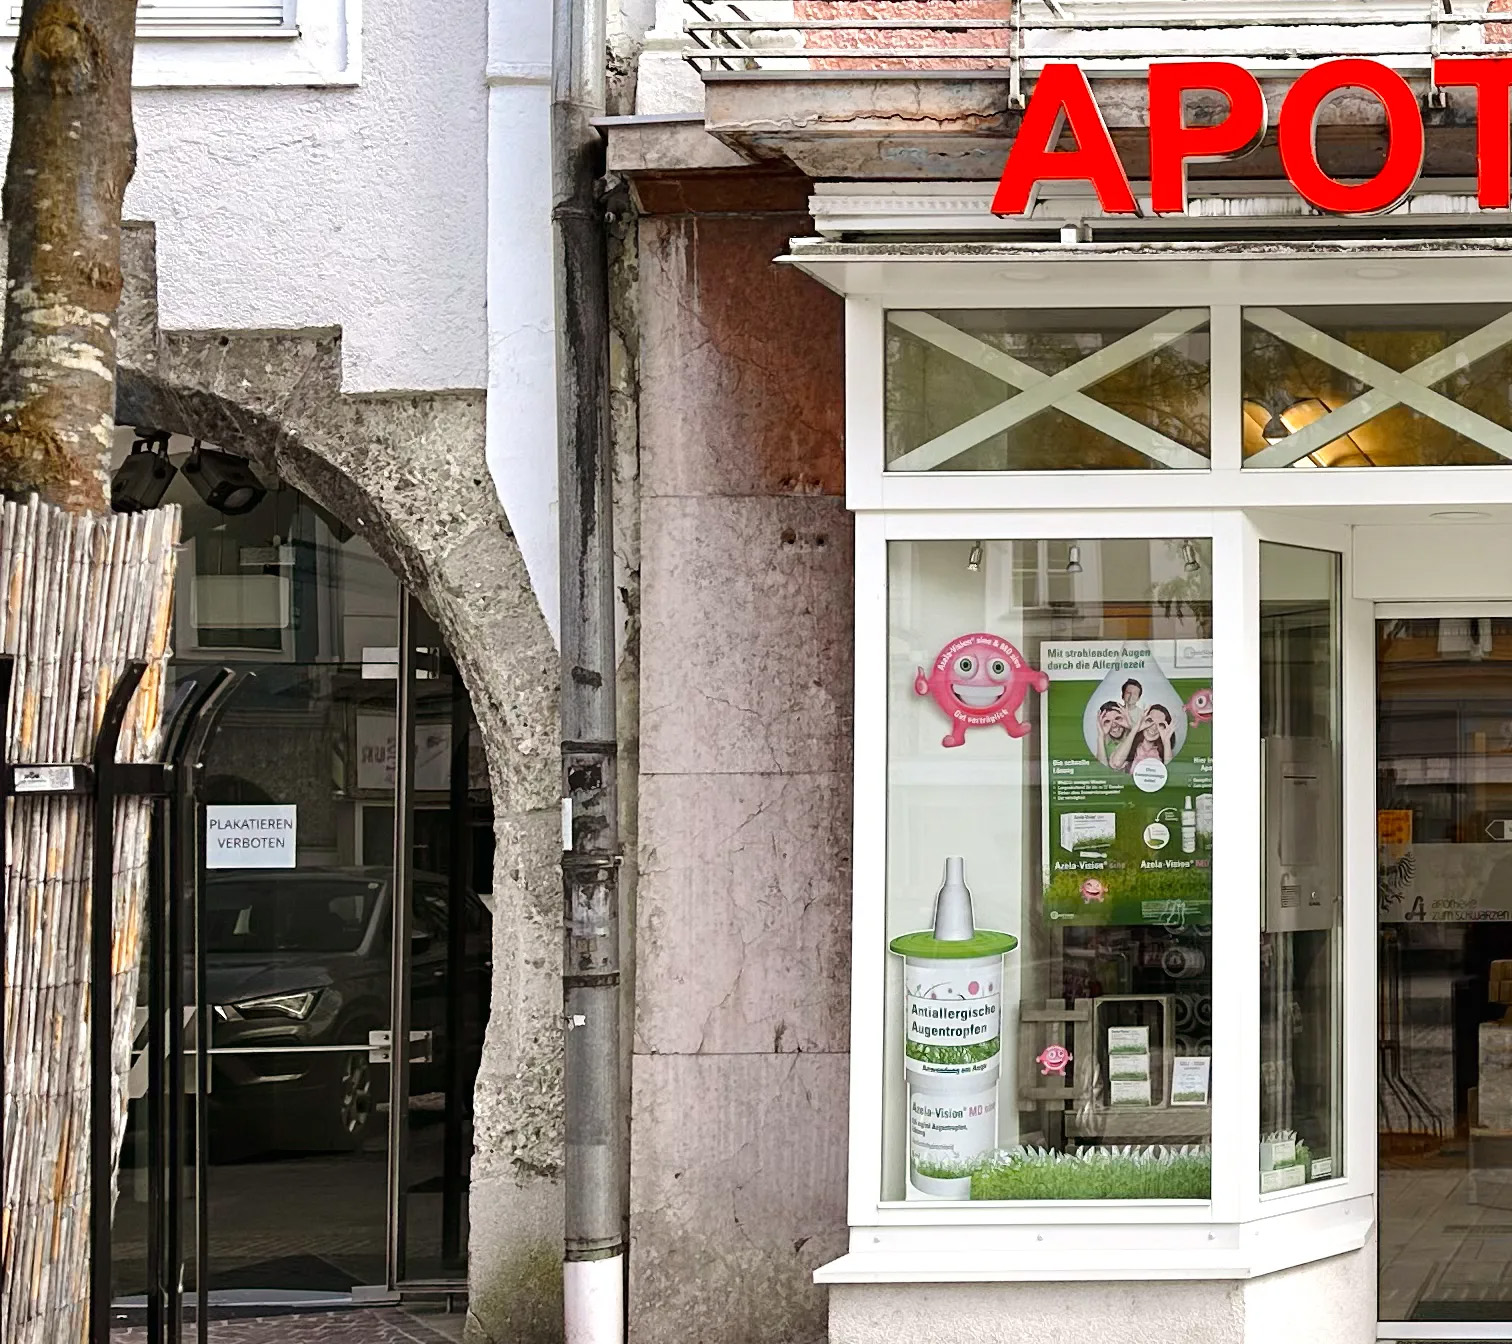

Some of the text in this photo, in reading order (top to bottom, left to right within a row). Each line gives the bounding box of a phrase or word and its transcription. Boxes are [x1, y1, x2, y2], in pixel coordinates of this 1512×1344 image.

[1047, 649, 1063, 657] Mit
[1121, 648, 1151, 659] Augen
[1076, 660, 1090, 669] die
[954, 709, 966, 721] Gut
[209, 819, 293, 830] PLAKATIEREN
[218, 837, 285, 848] VERBOTEN
[911, 1003, 996, 1021] Antiallergische
[911, 1020, 988, 1039] Augentropfen
[968, 1104, 984, 1118] MD
